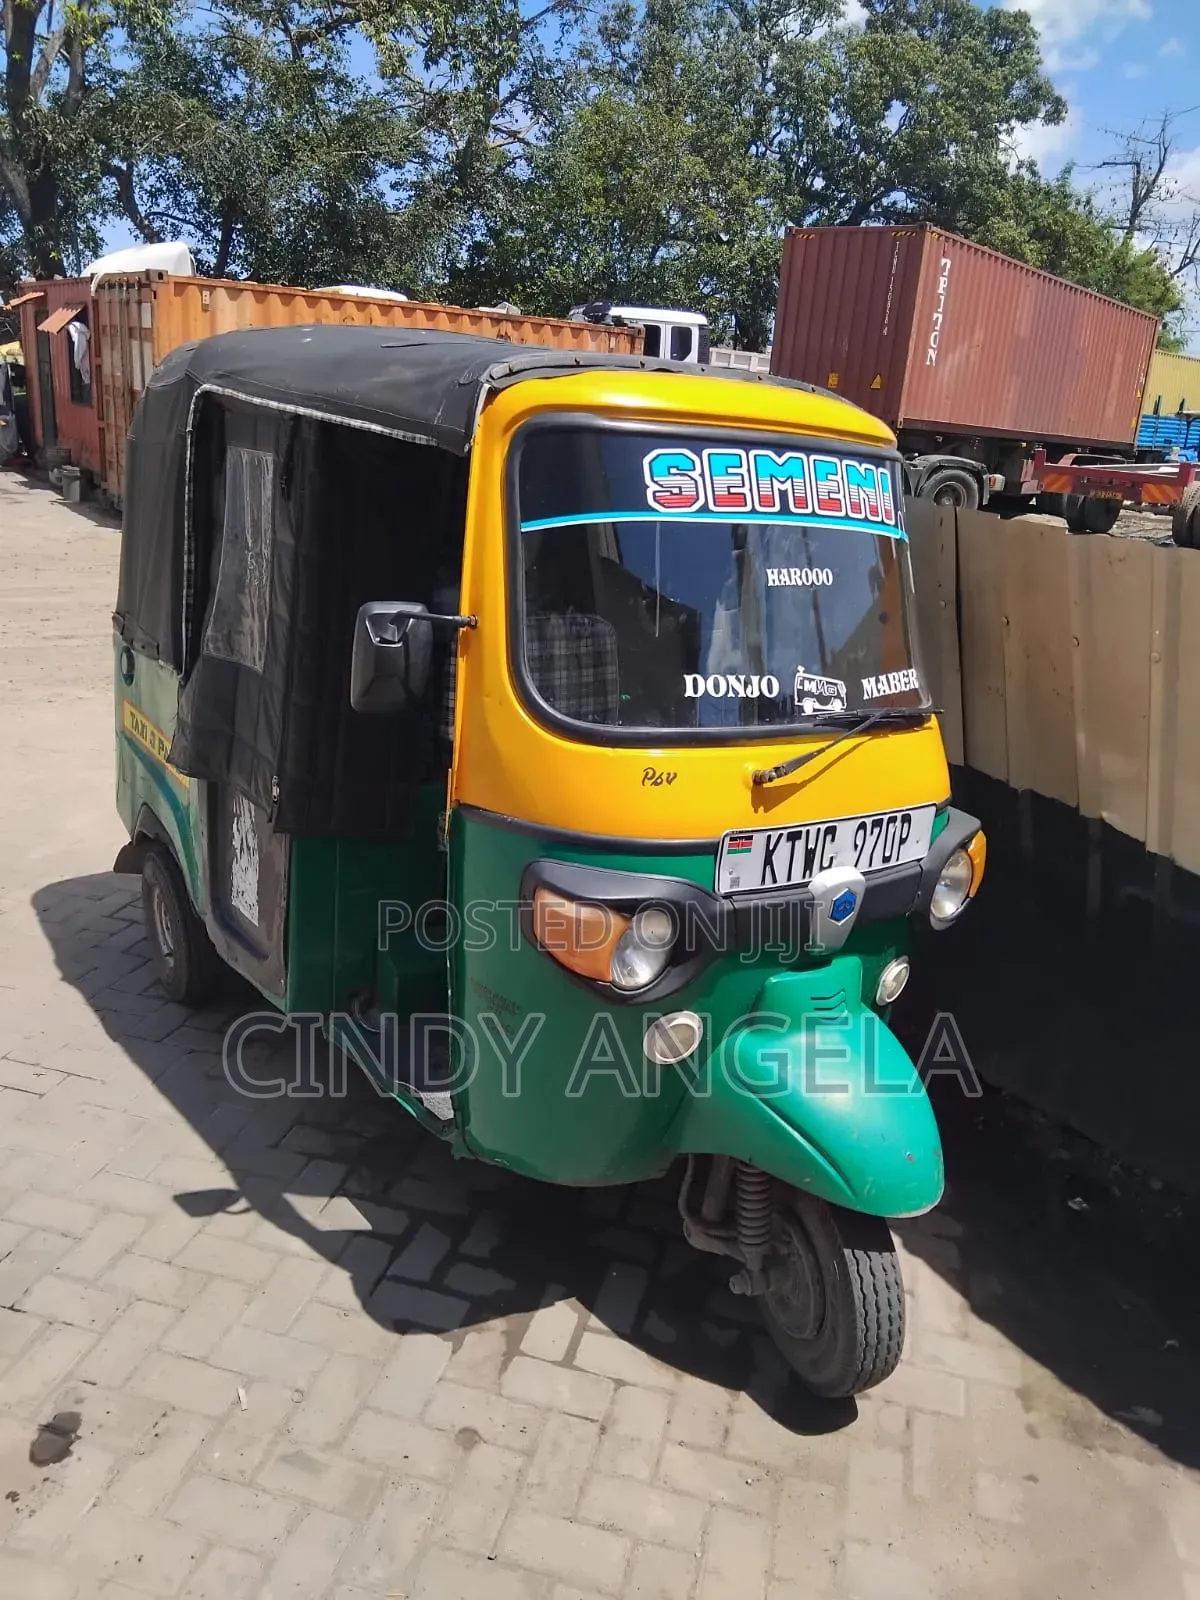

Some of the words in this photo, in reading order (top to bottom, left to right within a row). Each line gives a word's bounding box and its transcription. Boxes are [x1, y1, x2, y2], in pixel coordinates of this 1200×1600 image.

[643, 448, 896, 525] SEMENI
[767, 567, 834, 587] HAROOO
[683, 673, 780, 699] DONJO
[861, 668, 920, 700] MABER
[761, 824, 838, 886] KTWC
